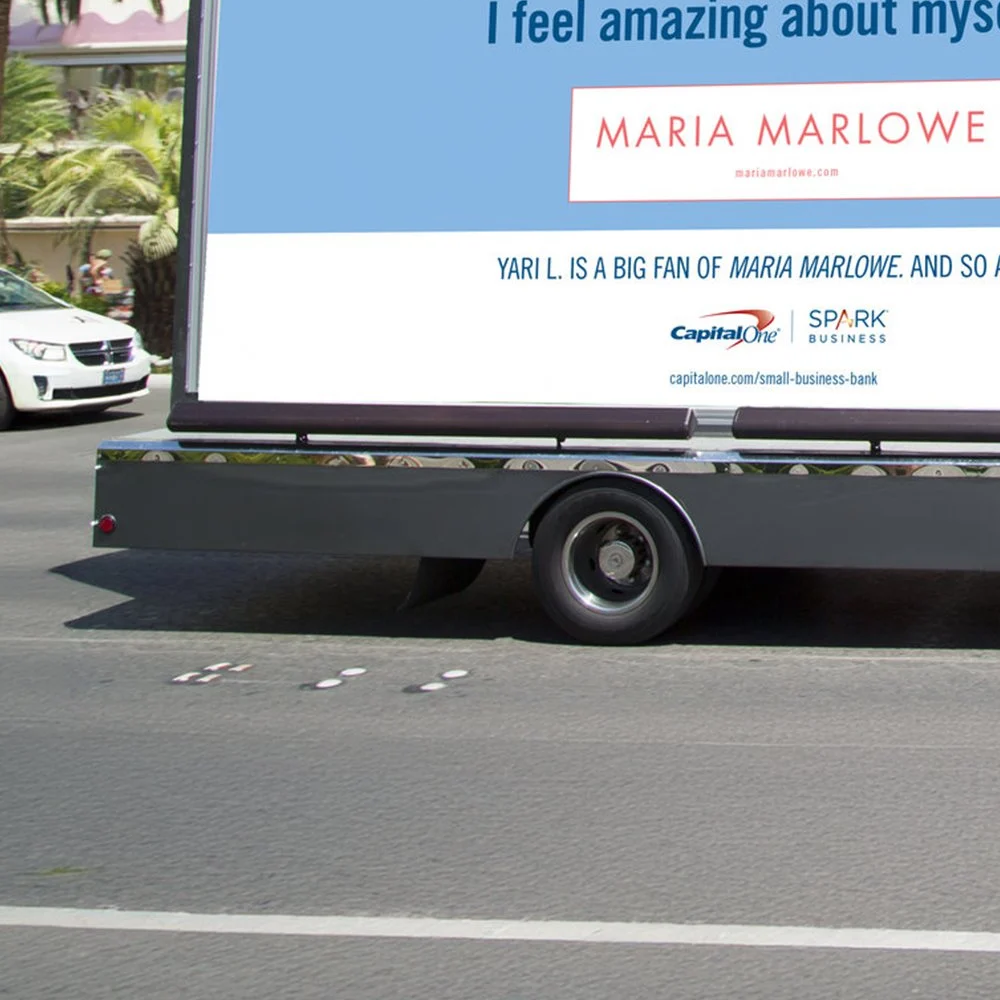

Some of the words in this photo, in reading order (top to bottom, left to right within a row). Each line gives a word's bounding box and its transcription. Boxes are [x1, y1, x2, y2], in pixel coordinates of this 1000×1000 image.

[488, 1, 497, 44] I
[512, 0, 585, 43] feel
[597, 115, 733, 148] MARIA
[758, 111, 984, 146] MARLOWE
[736, 168, 838, 178] mariamarlowe.com
[498, 257, 539, 280] YARI
[547, 257, 562, 279] L.
[571, 256, 587, 280] IS
[594, 257, 606, 279] A
[614, 256, 645, 279] BIG
[654, 256, 689, 279] FAN
[697, 256, 722, 279] OF
[730, 256, 792, 278] MARIA
[800, 255, 903, 278] MARLOWE.
[910, 255, 952, 278] AND
[961, 254, 987, 278] SO
[809, 309, 886, 330] SPARK
[809, 334, 886, 343] BUSINESS
[670, 371, 878, 387] capitalone.com/small-business-bank
